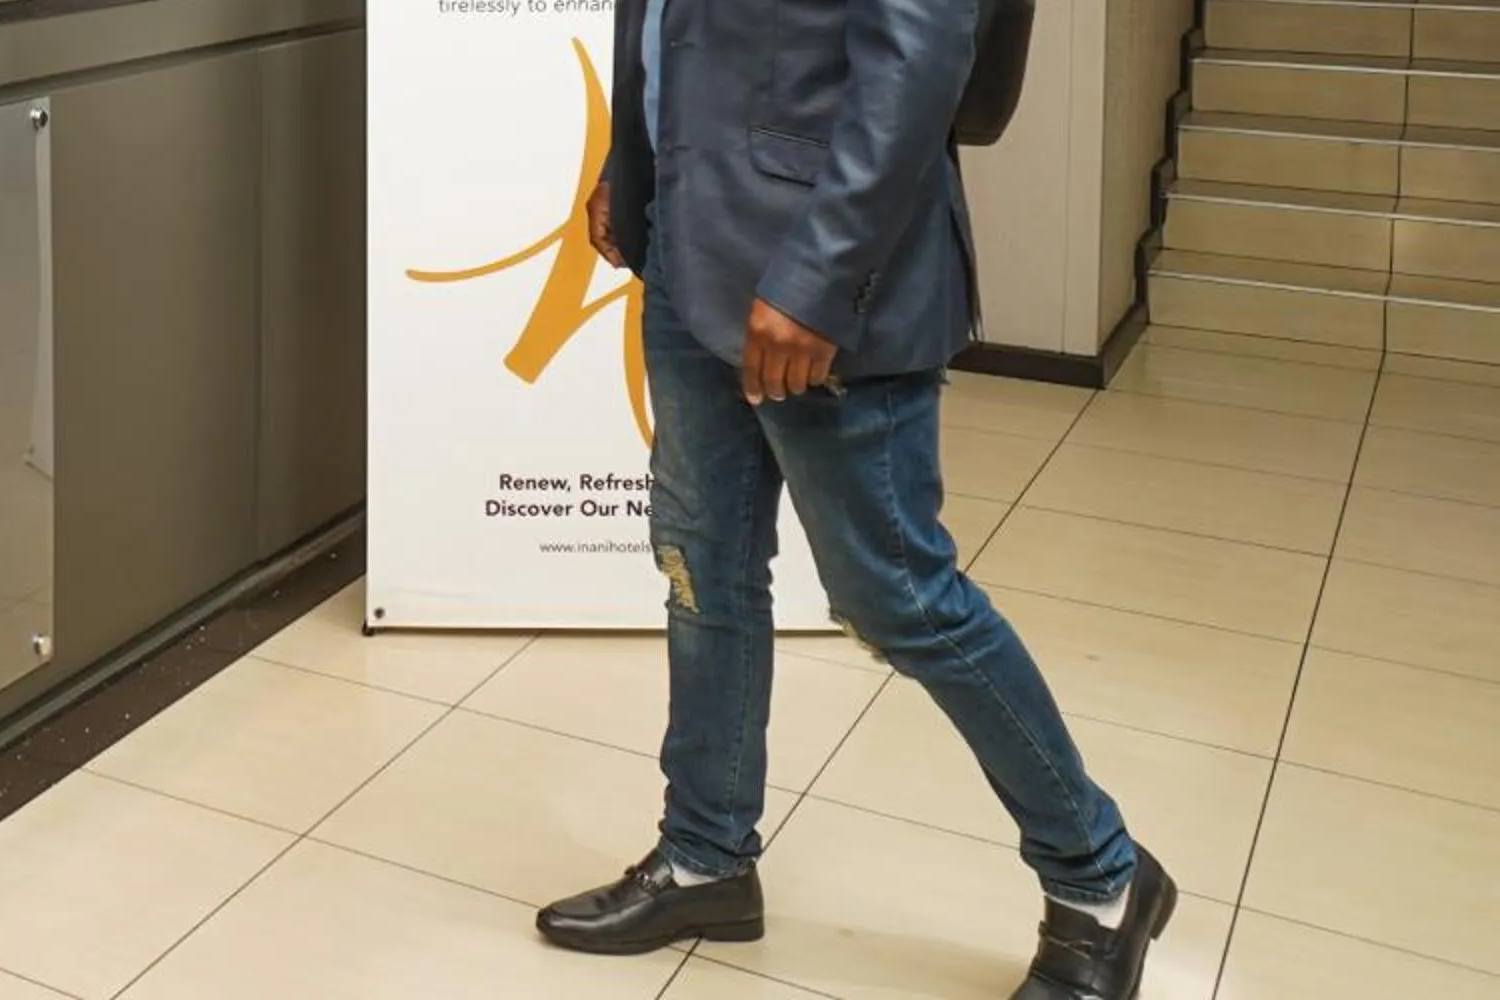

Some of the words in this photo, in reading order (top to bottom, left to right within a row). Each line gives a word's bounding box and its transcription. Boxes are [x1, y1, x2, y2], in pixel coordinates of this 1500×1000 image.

[499, 473, 572, 492] Renew,
[485, 500, 574, 517] Discover
[580, 500, 619, 517] Our
[626, 500, 653, 516] Ne
[539, 541, 651, 554] www.inanihotels
